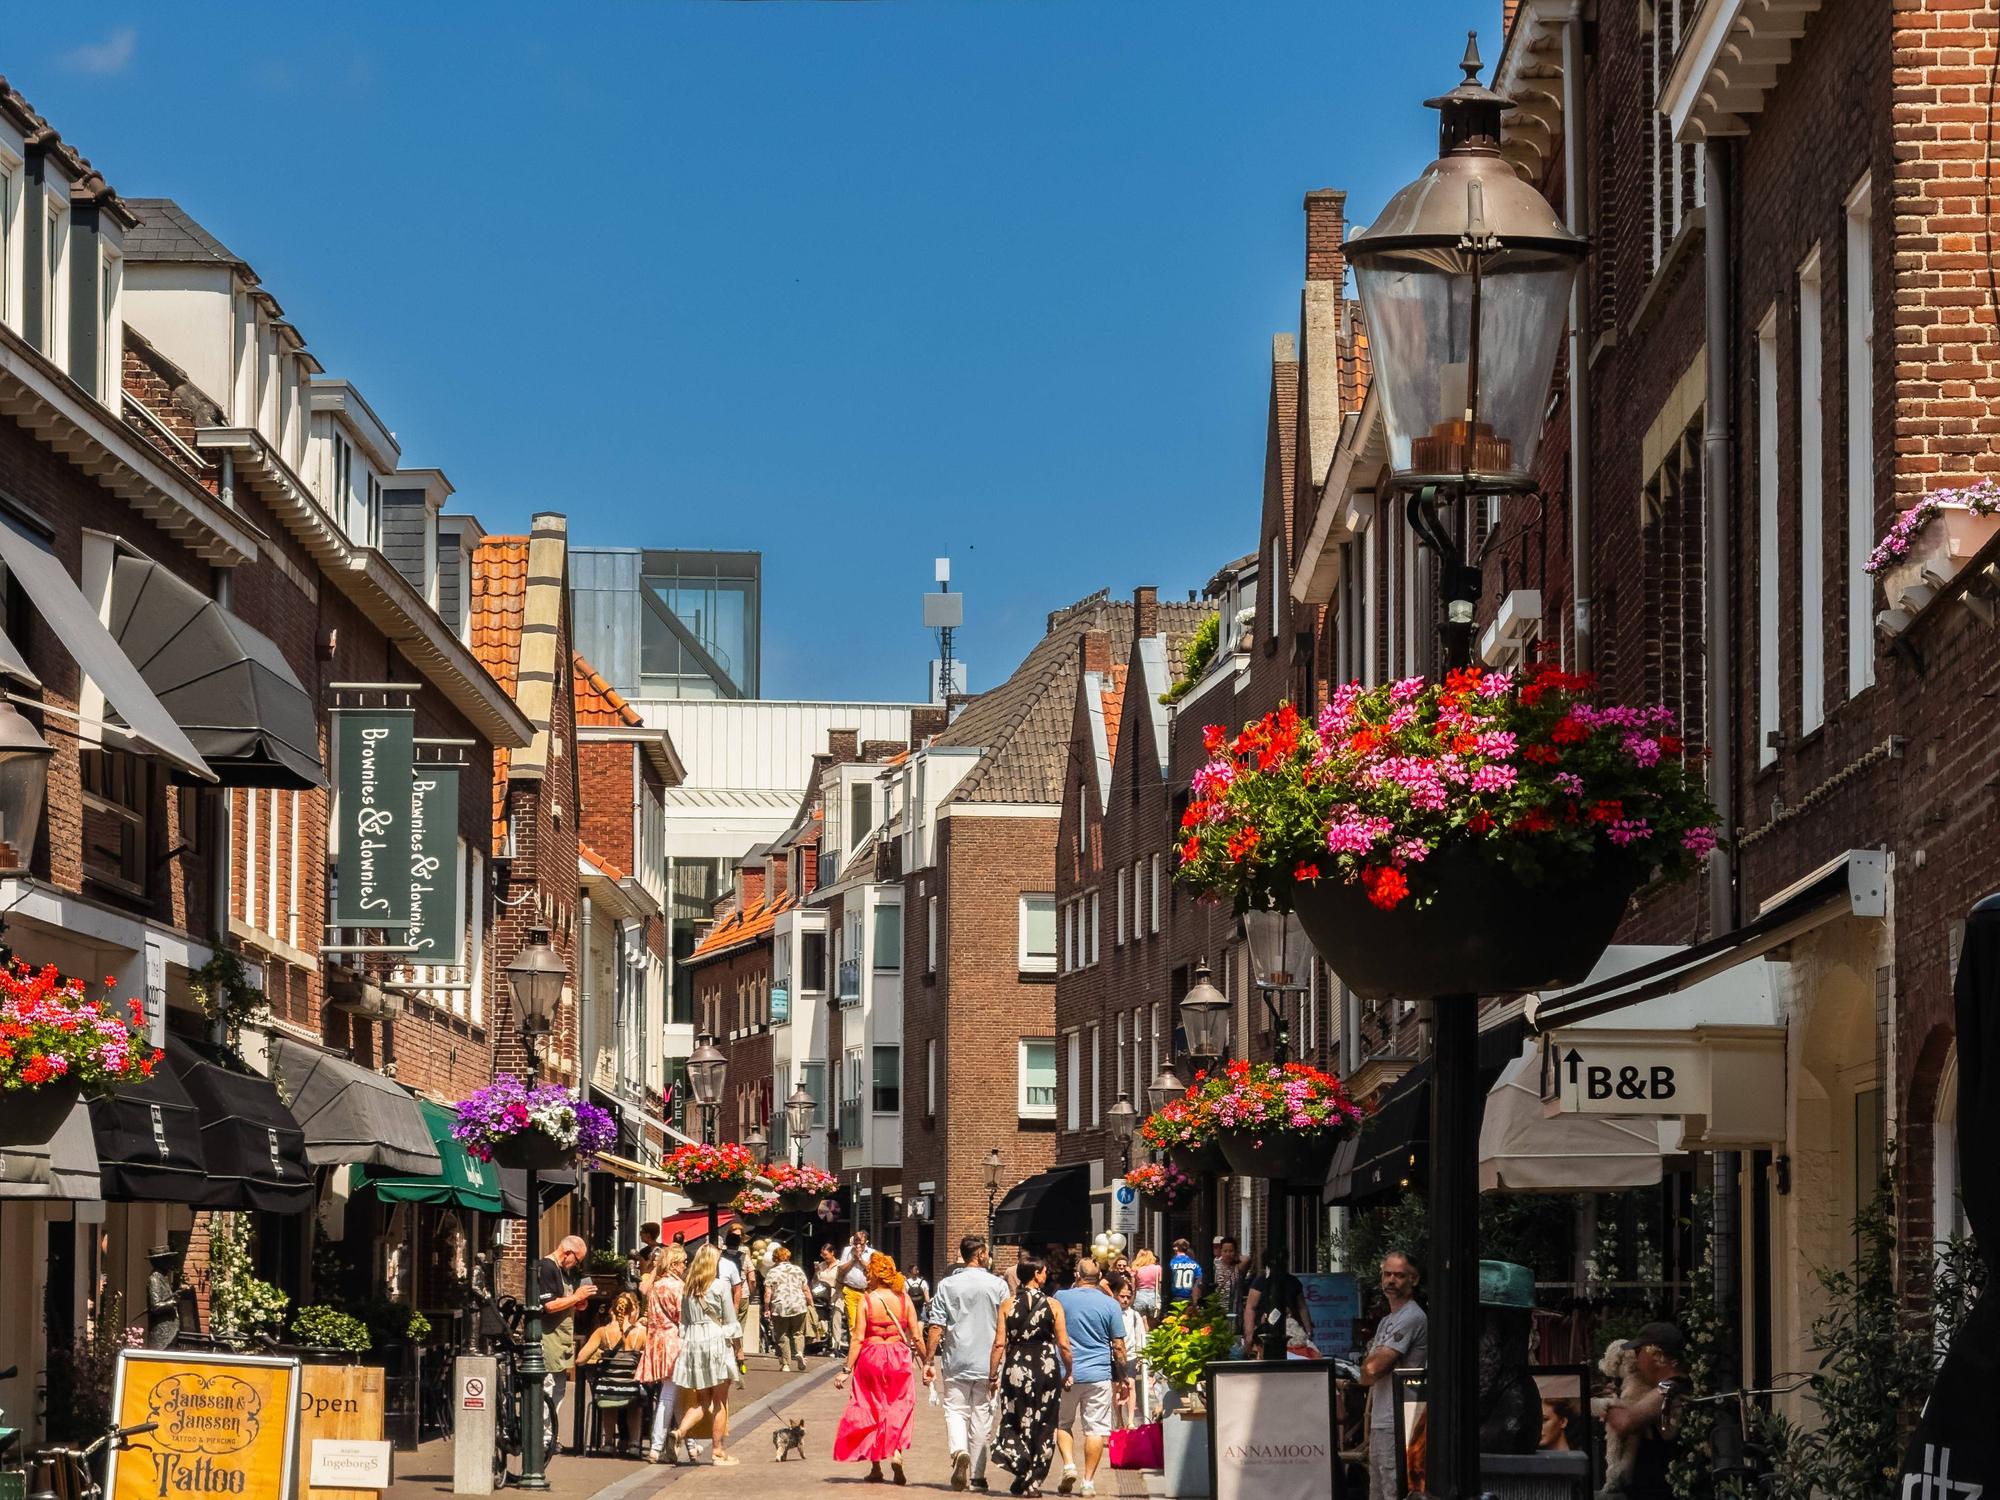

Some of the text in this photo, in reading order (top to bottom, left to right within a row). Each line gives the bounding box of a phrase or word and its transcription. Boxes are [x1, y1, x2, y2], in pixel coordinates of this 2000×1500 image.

[361, 728, 389, 805] Brownies
[358, 807, 393, 837] &
[411, 780, 437, 851] Brownies
[410, 853, 439, 880] &
[1587, 1065, 1676, 1100] B&B
[1175, 1269, 1194, 1289] 10
[163, 1386, 247, 1415] Janssen &
[300, 1391, 359, 1418] Open
[169, 1409, 241, 1437] Janssen
[1224, 1445, 1325, 1458] ANNAMOON
[152, 1453, 245, 1497] Tattoo
